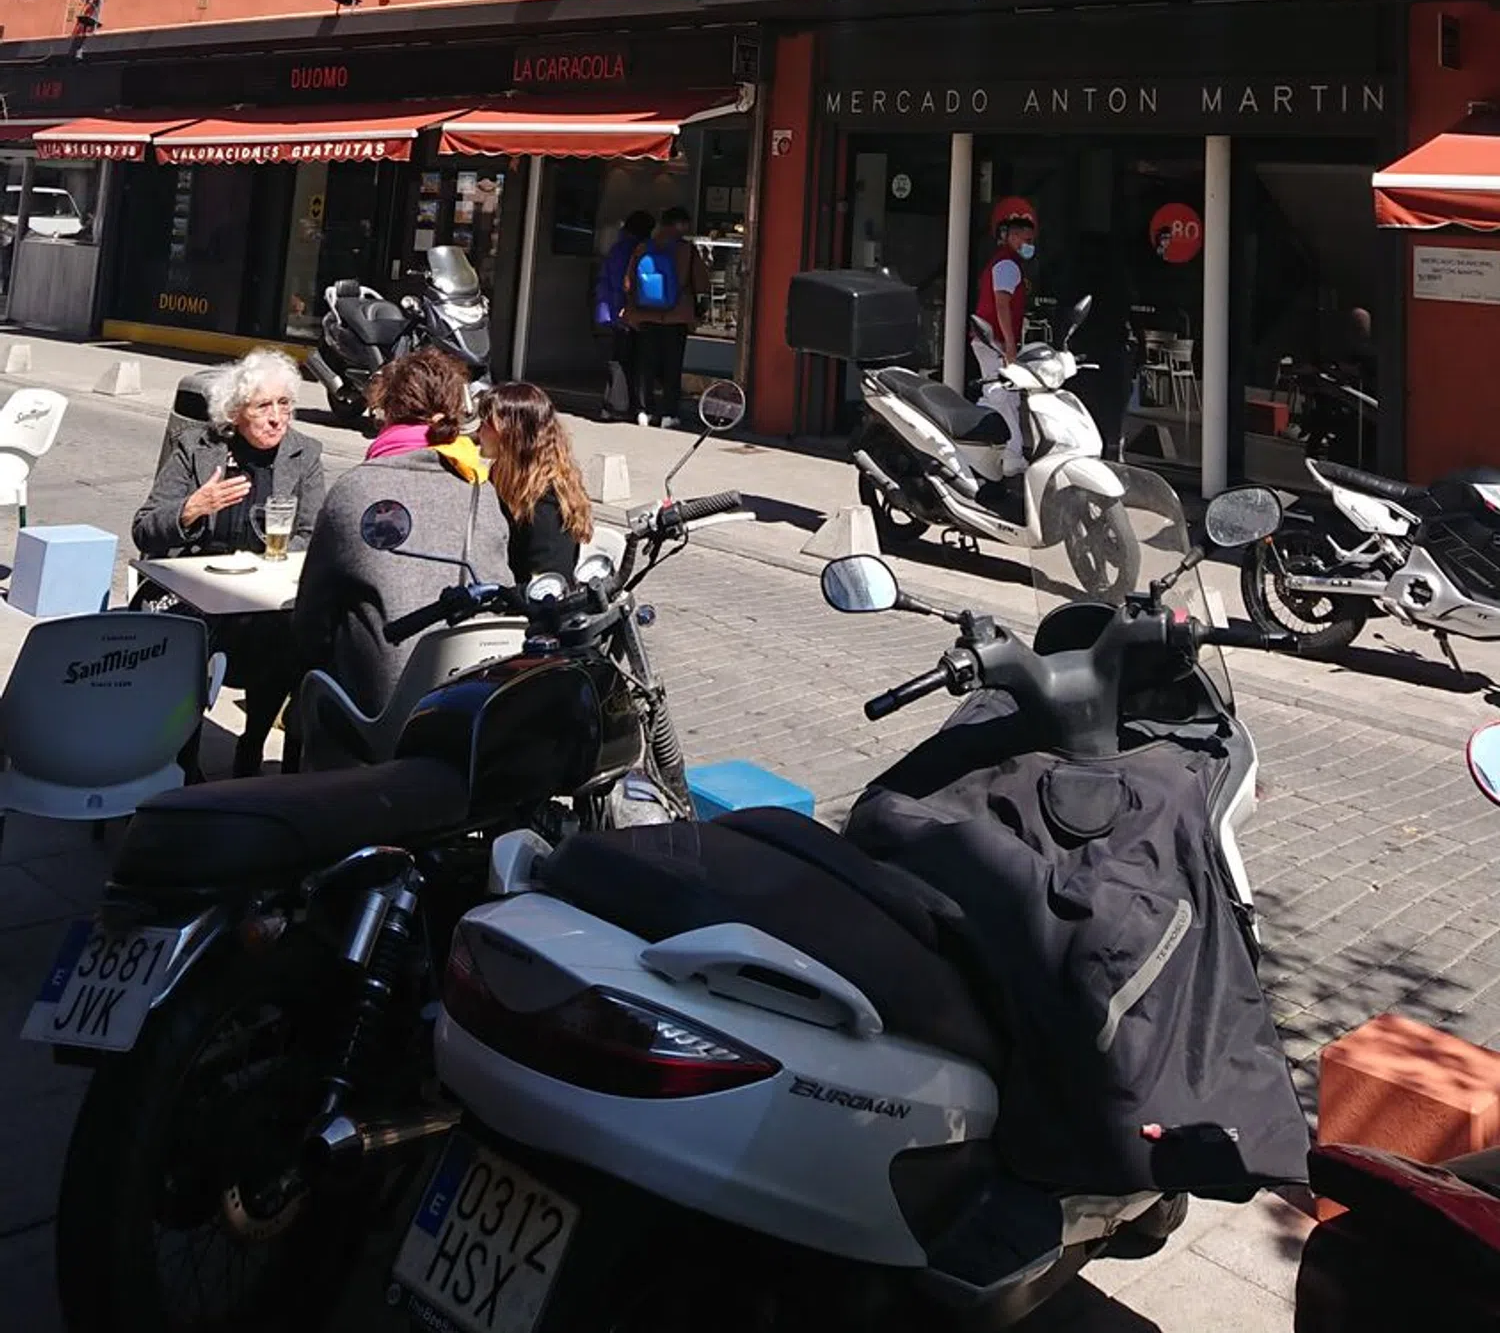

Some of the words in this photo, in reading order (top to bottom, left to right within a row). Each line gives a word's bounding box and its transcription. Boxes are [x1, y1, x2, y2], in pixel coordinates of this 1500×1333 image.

[291, 66, 348, 89] DUOMO
[513, 58, 533, 82] LA
[536, 54, 625, 81] CARACOLA
[826, 89, 990, 113] MERCADO
[1023, 87, 1159, 113] ANTON
[1201, 84, 1387, 113] MARTIN
[171, 145, 279, 161] VALORACIONES
[291, 142, 385, 158] GRATUITAS
[1172, 220, 1199, 240] 80
[159, 293, 208, 314] DUOMO
[78, 934, 166, 985] 3681
[53, 984, 127, 1036] JVK
[788, 1075, 913, 1120] BURGMAN
[457, 1162, 563, 1274] 0312
[425, 1220, 517, 1328] HSX
